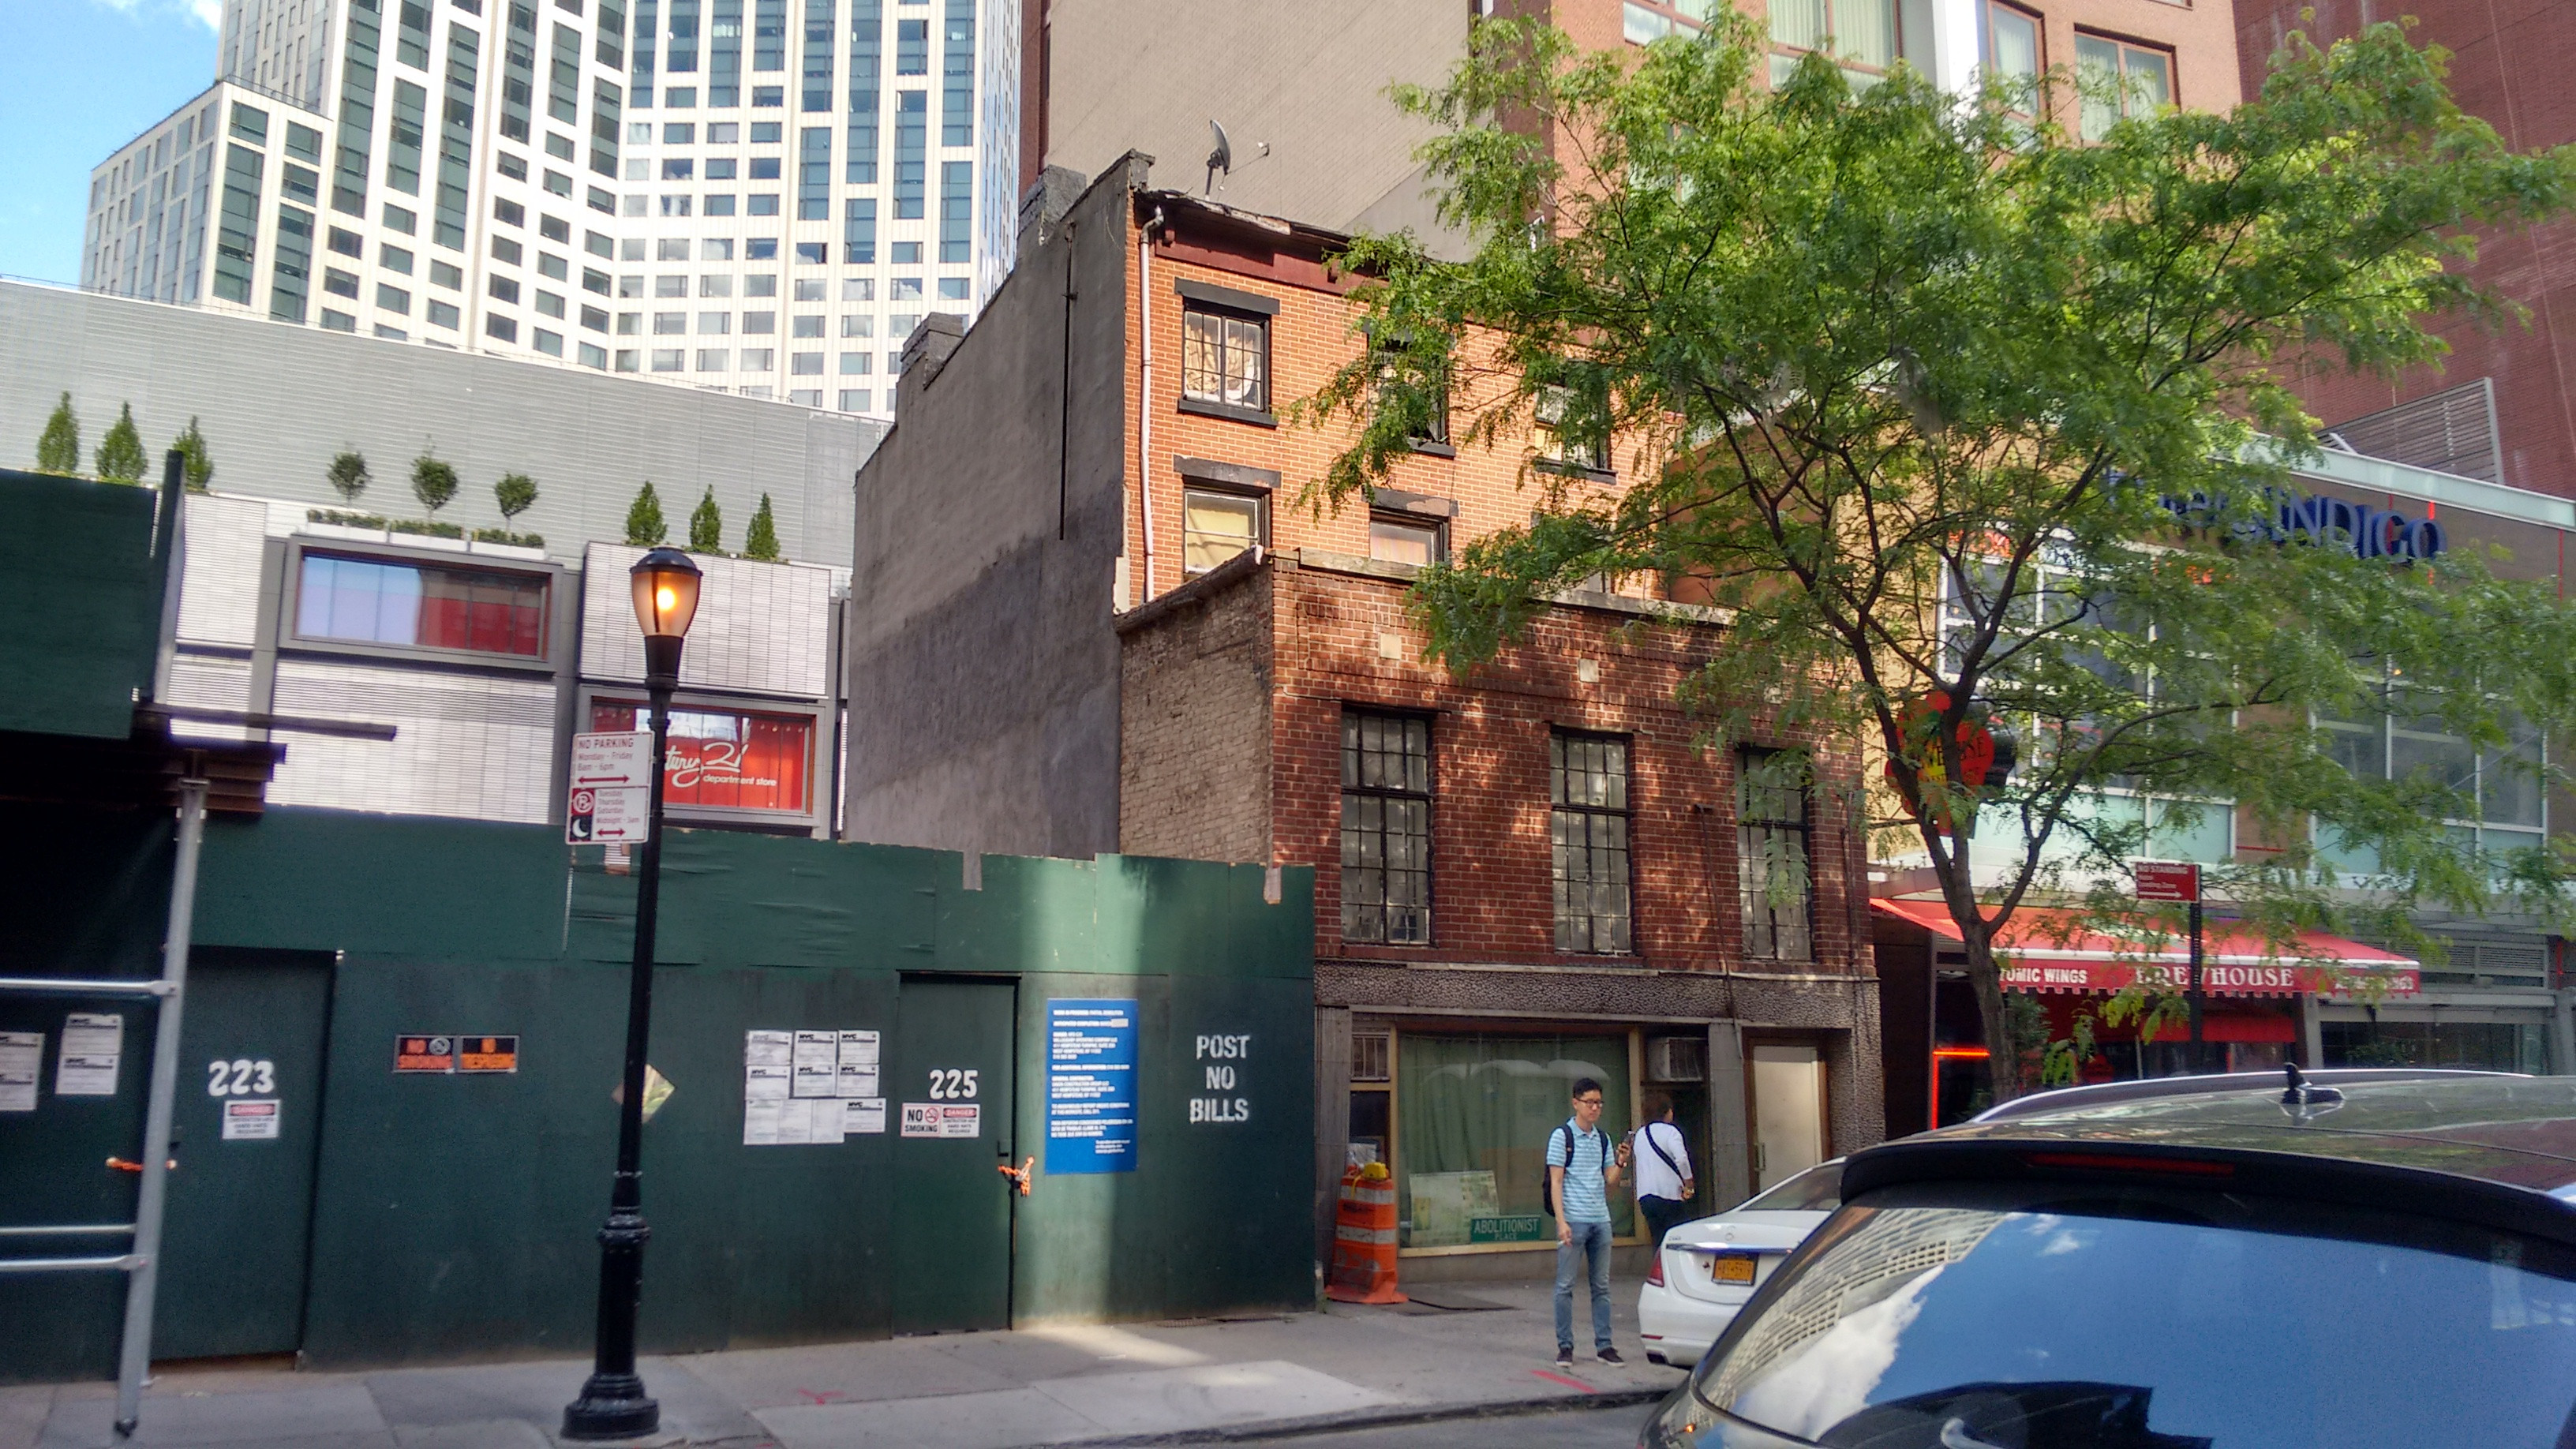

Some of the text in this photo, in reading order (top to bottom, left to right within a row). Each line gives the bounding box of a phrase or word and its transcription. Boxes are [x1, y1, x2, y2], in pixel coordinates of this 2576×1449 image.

[578, 738, 634, 749] NO PARKING
[702, 773, 777, 786] department store
[1999, 968, 2087, 984] TOMIC WINGS
[1196, 1035, 1251, 1060] POST
[208, 1059, 275, 1097] 223
[930, 1069, 979, 1100] 225
[1206, 1065, 1236, 1090] NO
[907, 1109, 923, 1122] NO
[1189, 1098, 1249, 1124] BILLS
[1473, 1218, 1539, 1234] ABOLITIONIST
